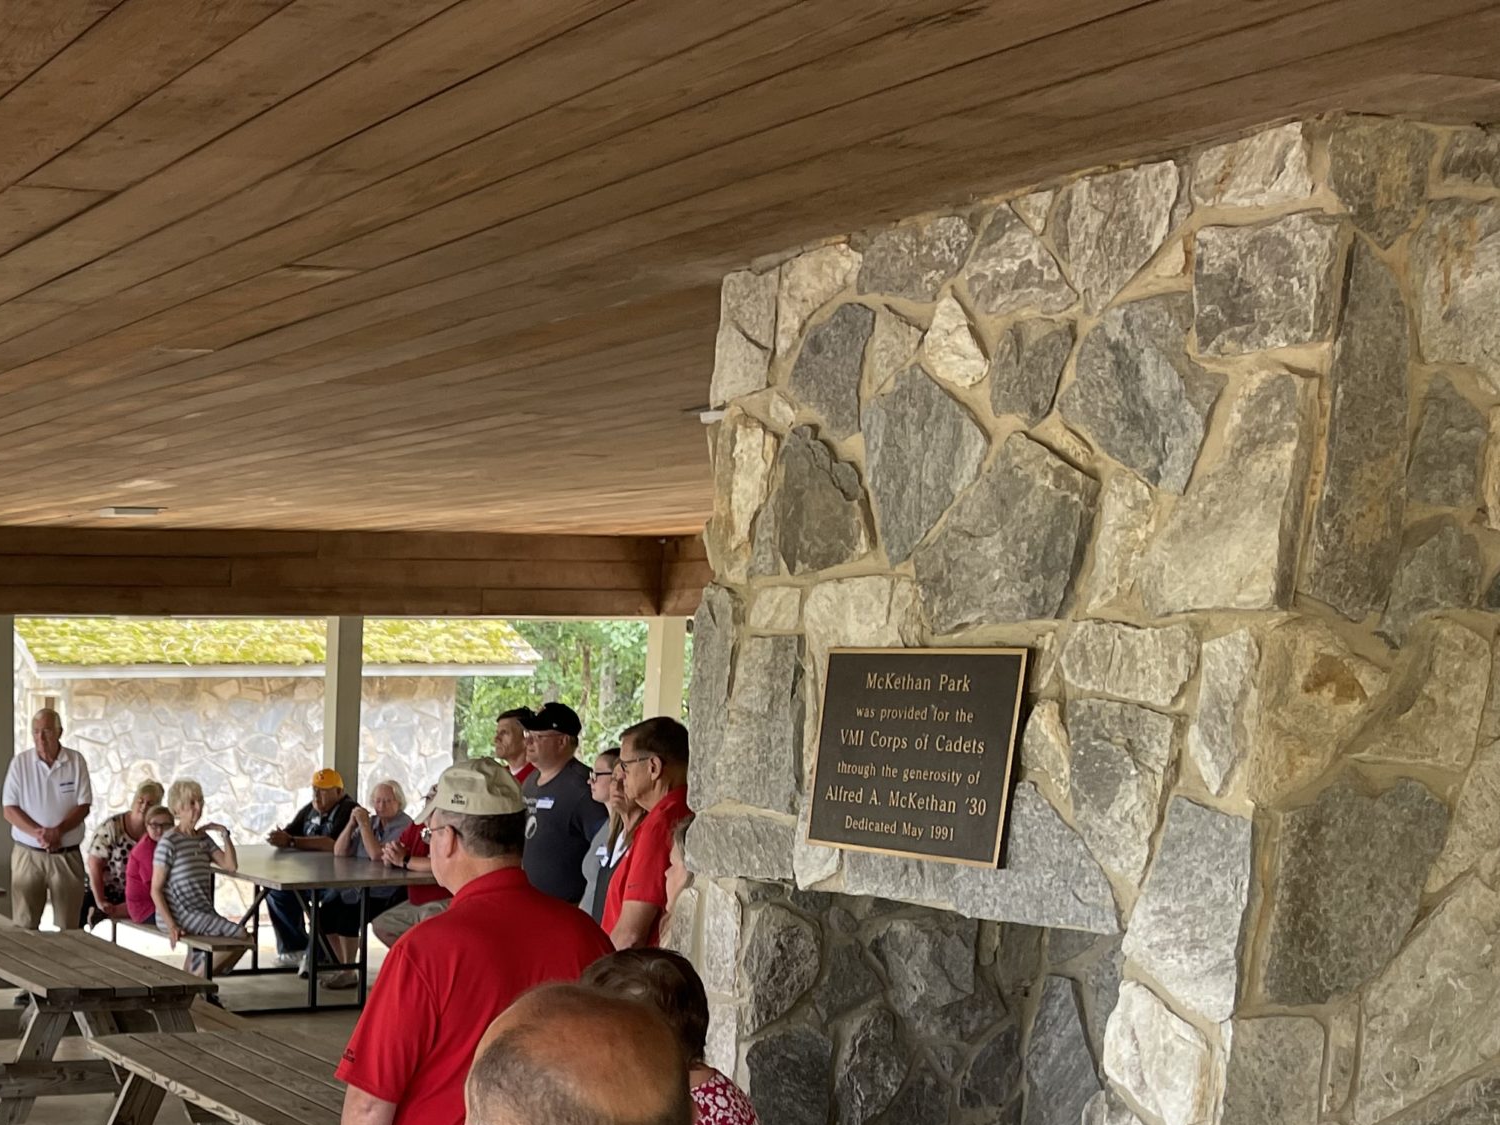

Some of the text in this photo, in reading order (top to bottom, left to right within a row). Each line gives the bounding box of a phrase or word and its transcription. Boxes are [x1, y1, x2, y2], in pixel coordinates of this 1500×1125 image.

[866, 672, 971, 692] McKethan Park
[856, 705, 974, 723] was provided for the
[840, 729, 985, 754] VMI Corps of Cadets
[837, 760, 981, 785] through the generosity of
[825, 784, 987, 816] Alfred A. McKethan '30
[845, 815, 955, 841] Dedicated May 1991
